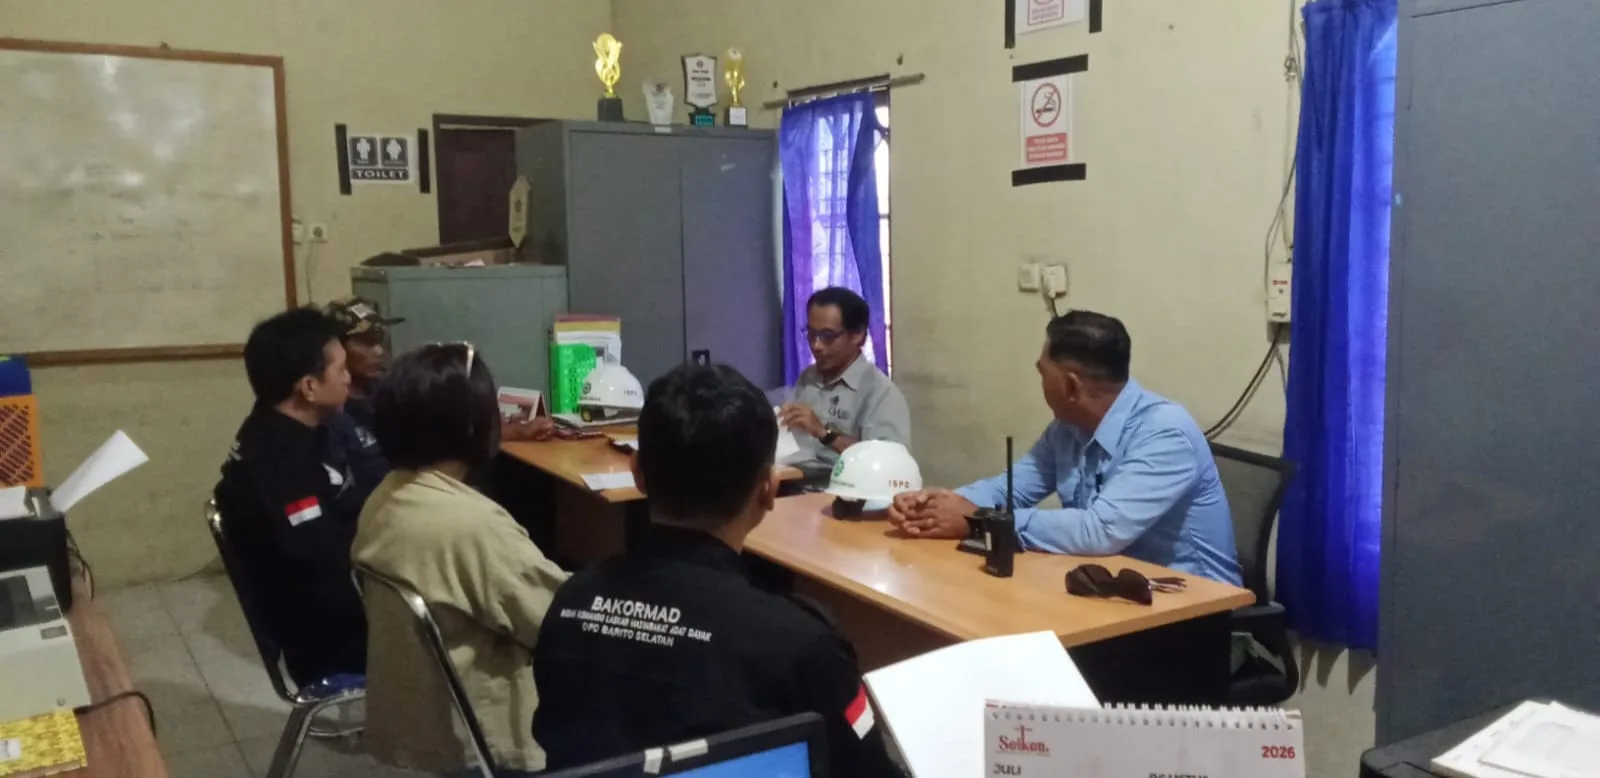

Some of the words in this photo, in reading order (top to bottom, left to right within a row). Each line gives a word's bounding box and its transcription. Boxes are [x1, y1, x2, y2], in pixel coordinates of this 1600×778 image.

[355, 169, 405, 178] TOILET
[591, 595, 682, 624] BAKORMAD
[601, 624, 635, 640] BARITO
[635, 630, 675, 648] SELATAN
[687, 627, 713, 643] DAYAK
[1261, 745, 1296, 759] 2026
[993, 763, 1022, 776] JULI
